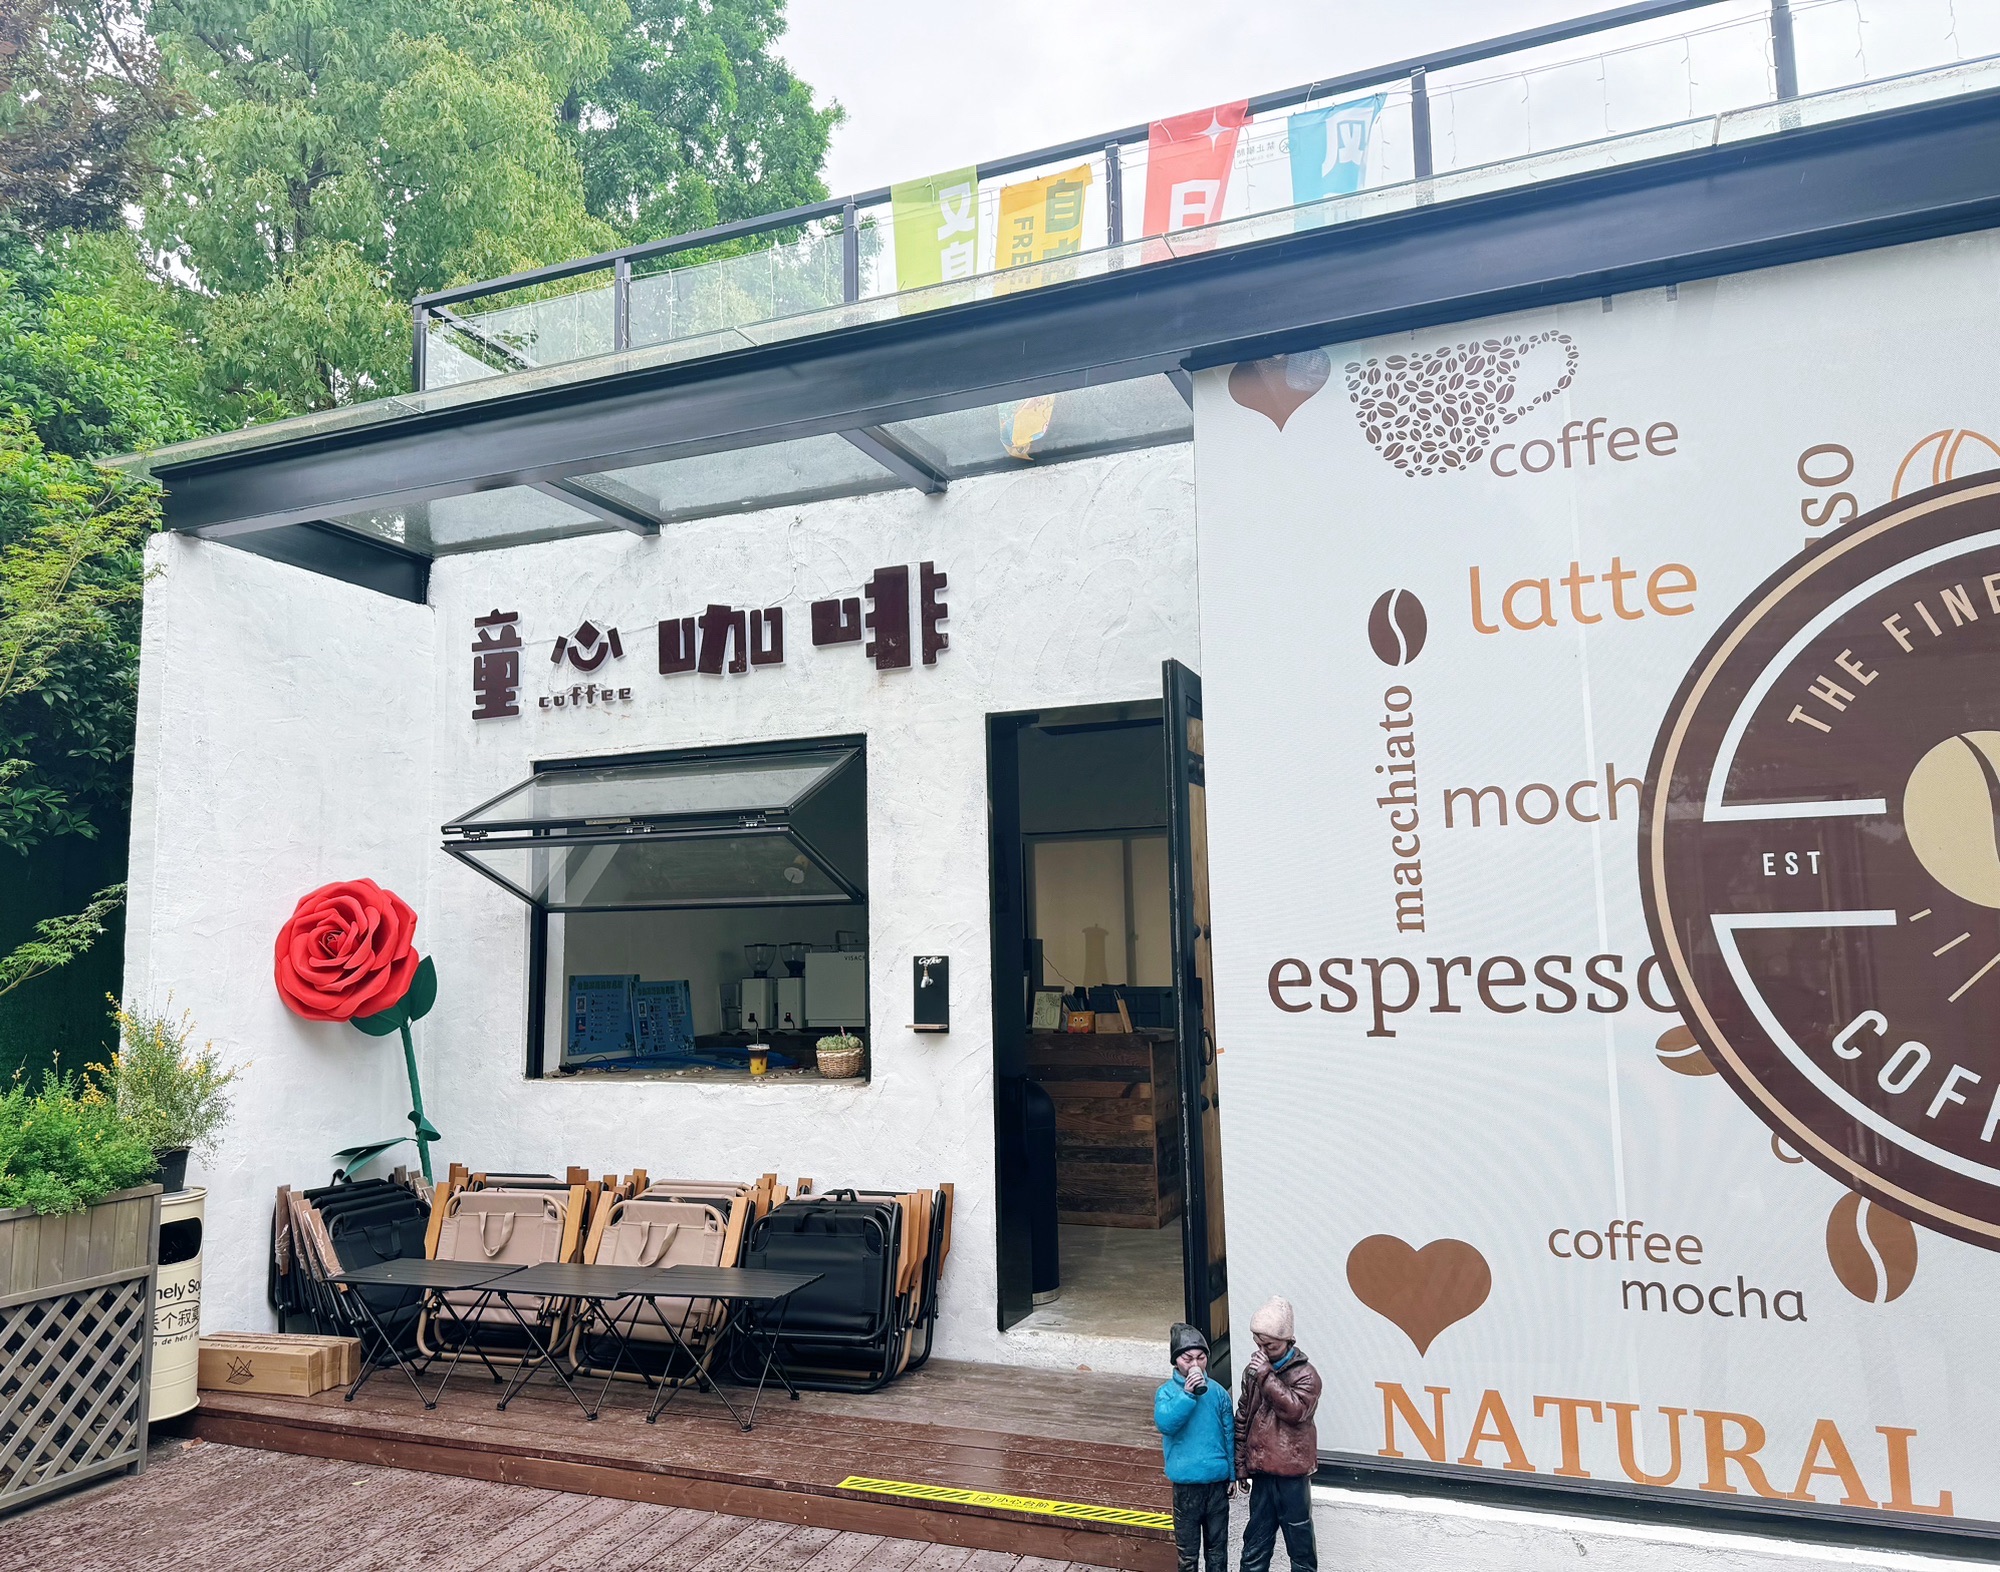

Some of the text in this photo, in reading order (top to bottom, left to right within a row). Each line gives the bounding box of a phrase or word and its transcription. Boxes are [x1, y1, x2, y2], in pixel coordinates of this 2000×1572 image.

[1489, 417, 1679, 478] coffee
[1797, 443, 1859, 549] SO
[1469, 556, 1698, 635] latte
[472, 561, 949, 719] 童心咖啡
[539, 684, 634, 709] coffee
[1787, 648, 1880, 733] THE
[1375, 685, 1426, 933] macchiato
[1762, 851, 1823, 877] EST
[1548, 1219, 1704, 1265] coffee
[1621, 1275, 1808, 1323] mocha
[1374, 1380, 1955, 1517] NATURAL
